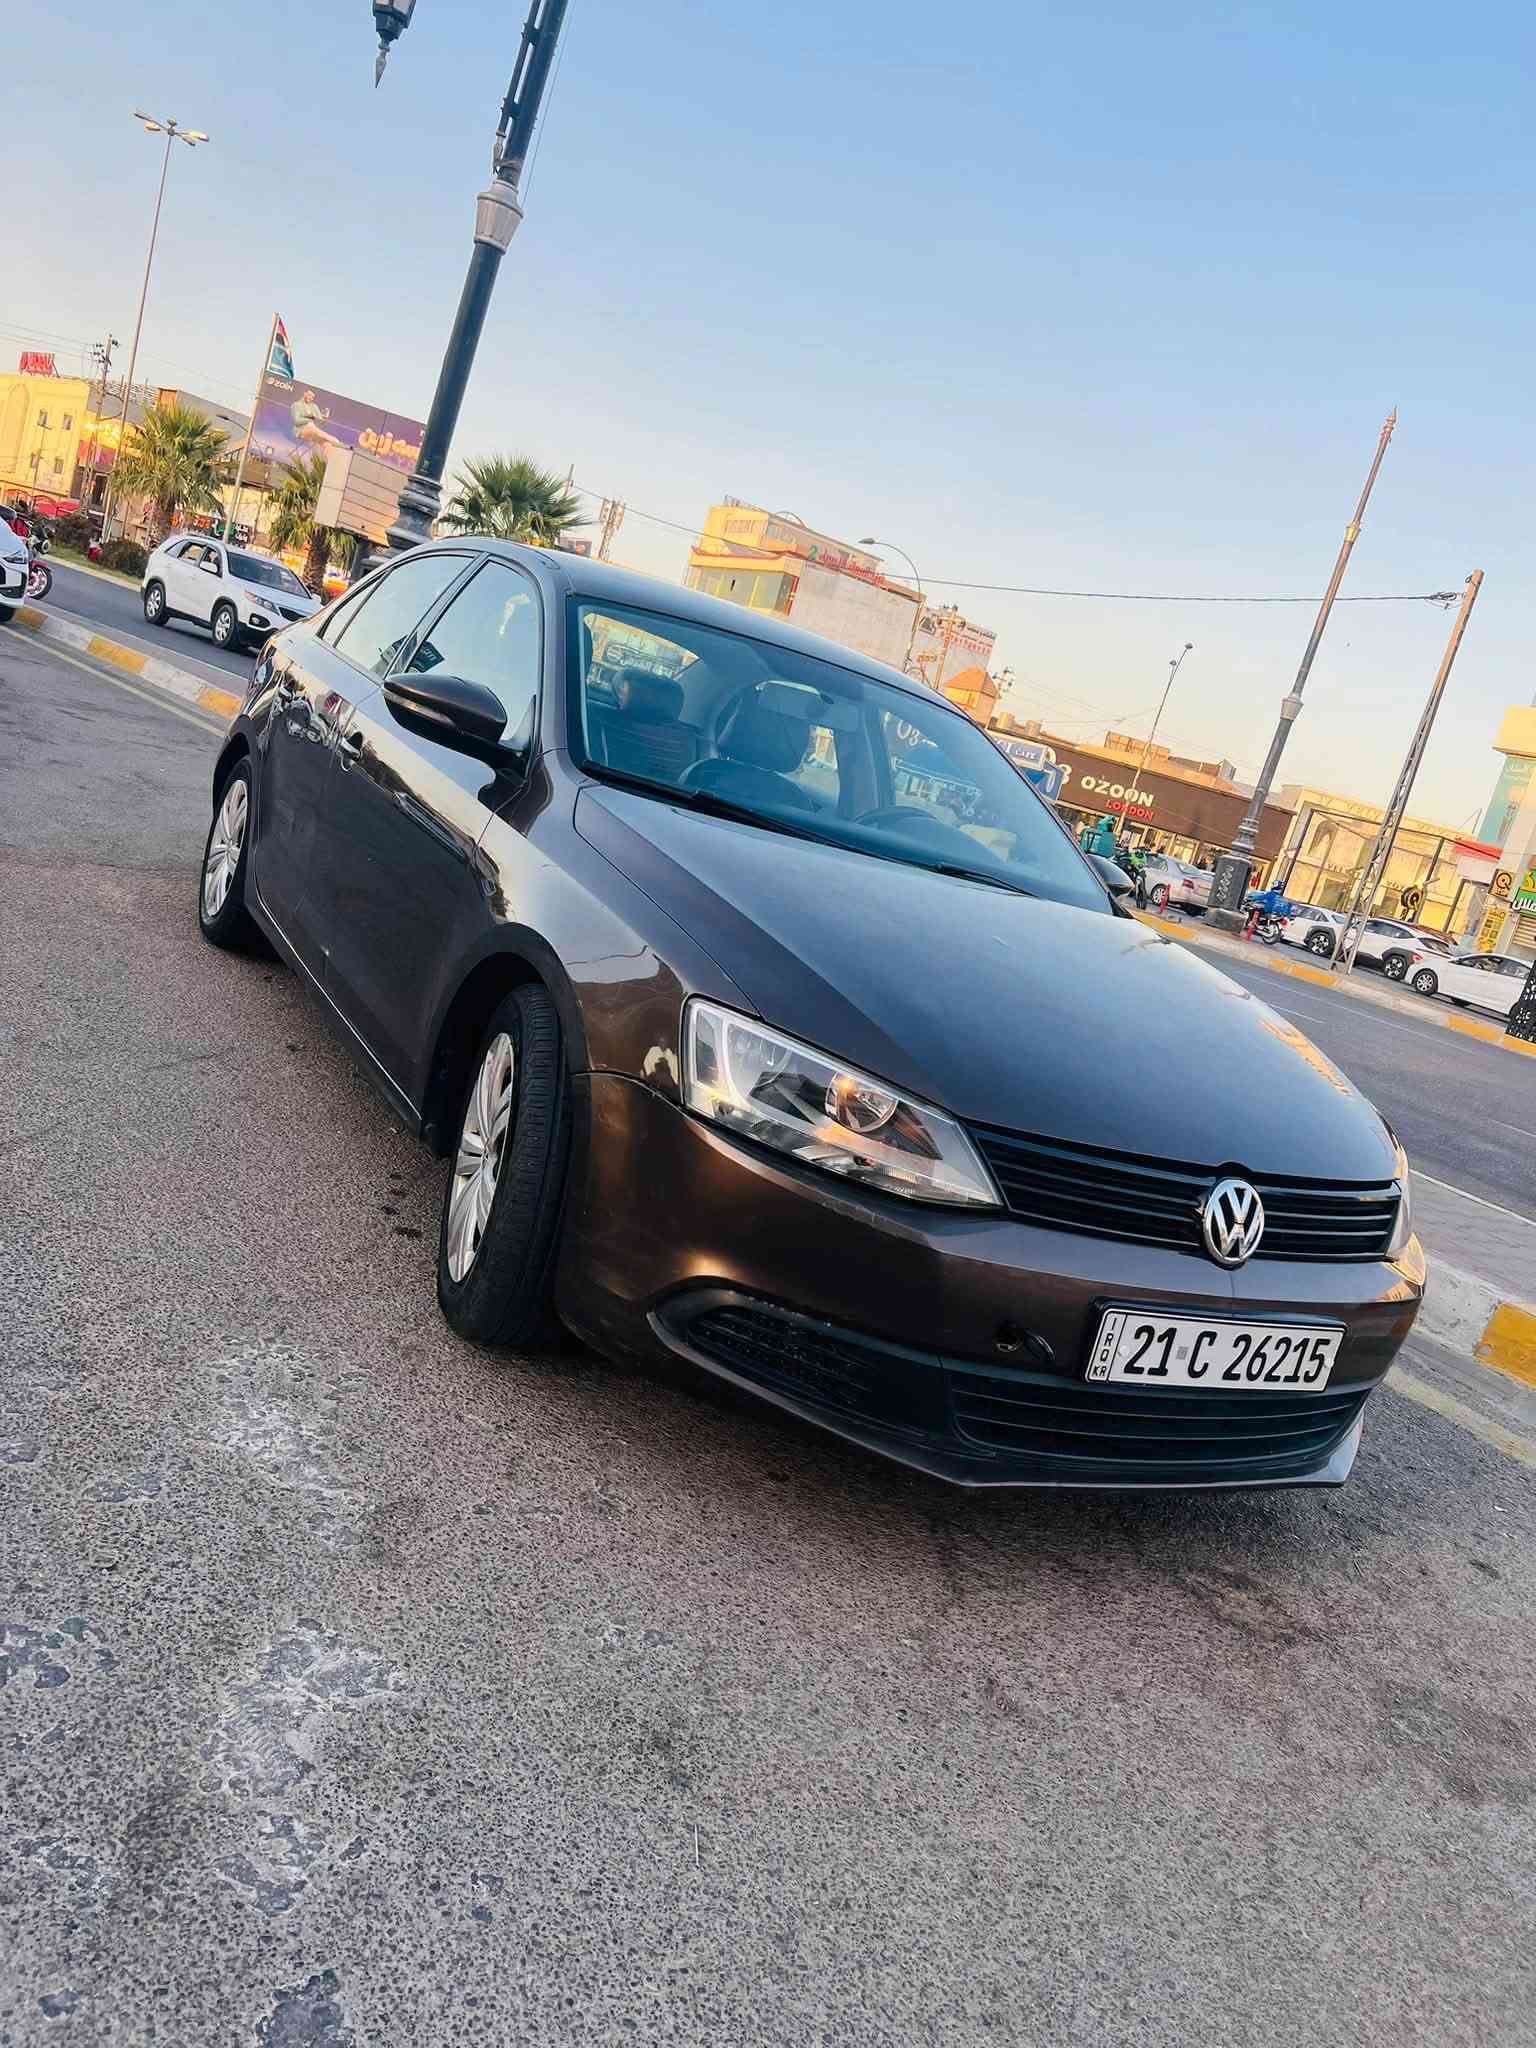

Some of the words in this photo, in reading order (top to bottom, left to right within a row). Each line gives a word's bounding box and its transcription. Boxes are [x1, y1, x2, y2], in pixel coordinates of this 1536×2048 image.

[1081, 775, 1154, 807] OZOON
[1123, 1324, 1177, 1377] 21
[1187, 1330, 1218, 1379] C
[1221, 1333, 1331, 1384] 26215
